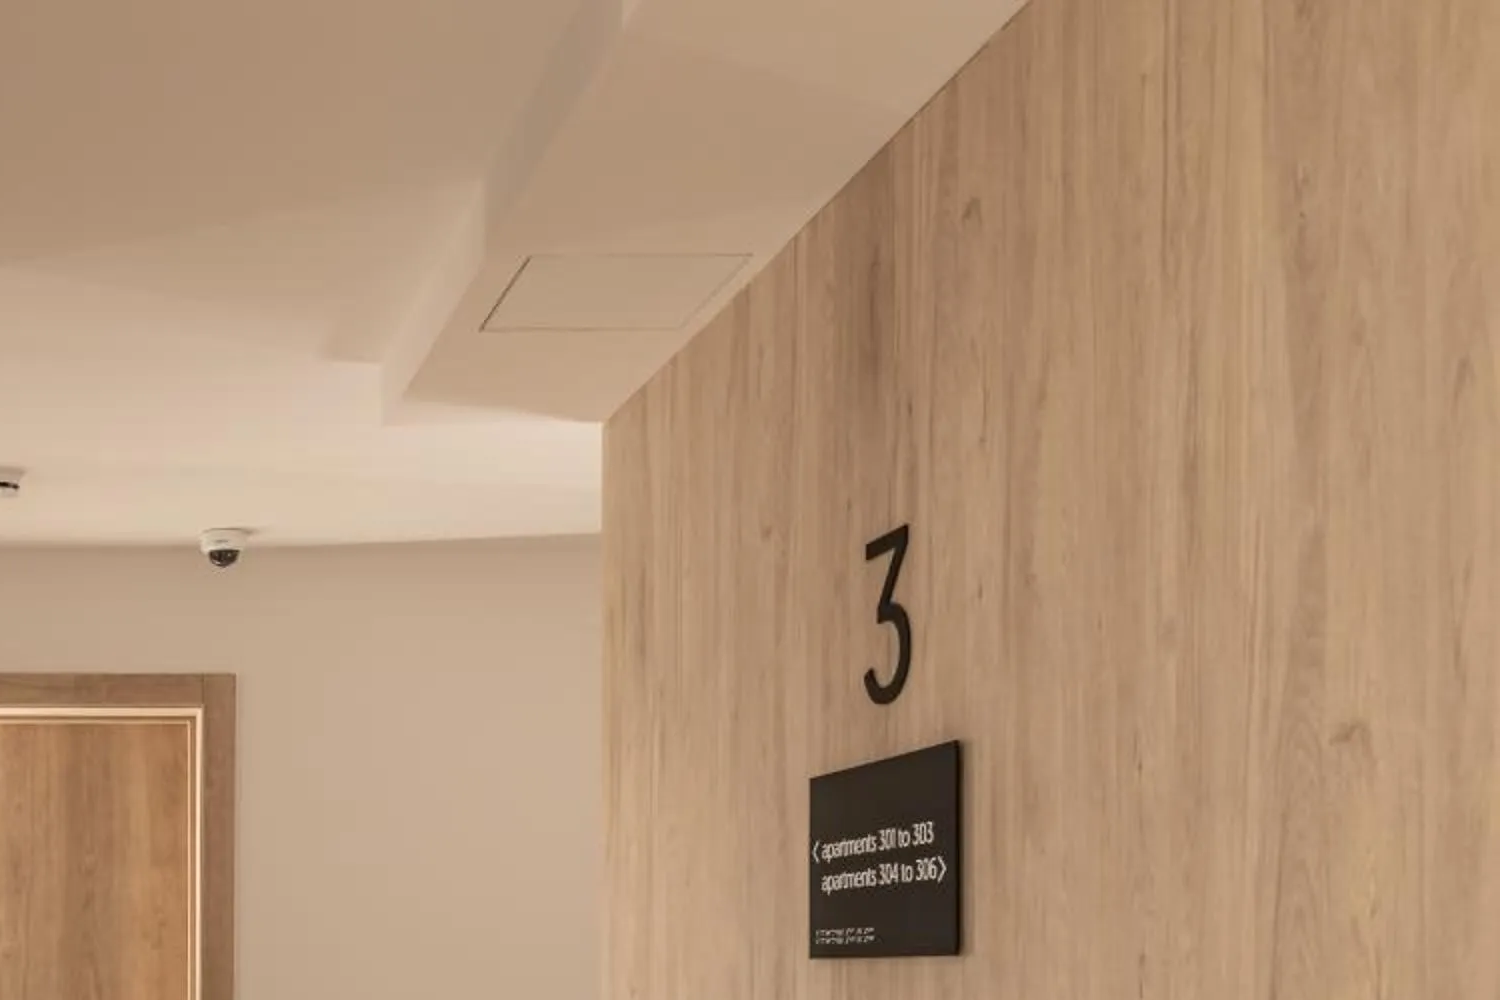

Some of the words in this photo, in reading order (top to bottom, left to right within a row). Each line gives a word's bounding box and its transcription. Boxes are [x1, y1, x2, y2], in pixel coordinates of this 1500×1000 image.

[864, 523, 912, 705] 3
[821, 834, 877, 864] apartments
[878, 828, 896, 851] 301
[897, 828, 911, 848] to
[912, 821, 935, 846] 303
[821, 868, 877, 896] apartments
[878, 863, 899, 885] 304
[901, 863, 914, 883] to
[915, 857, 938, 881] 306
